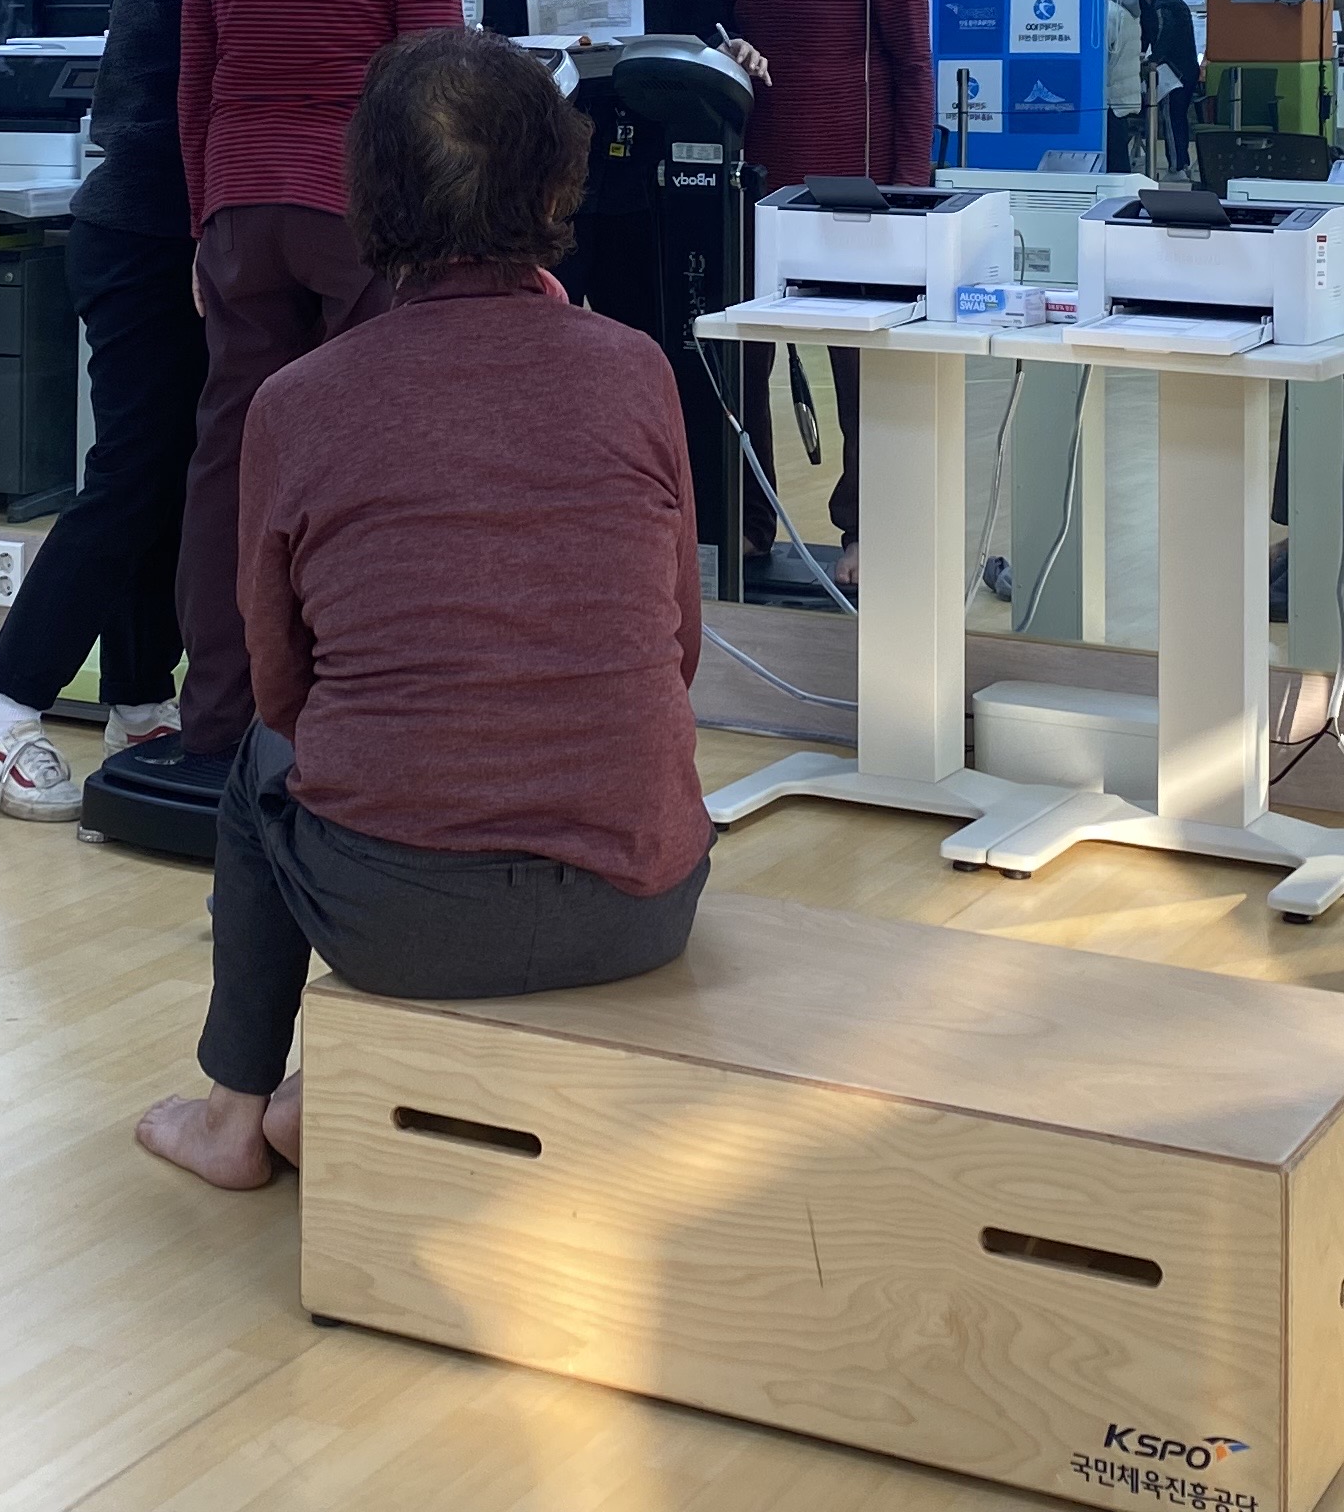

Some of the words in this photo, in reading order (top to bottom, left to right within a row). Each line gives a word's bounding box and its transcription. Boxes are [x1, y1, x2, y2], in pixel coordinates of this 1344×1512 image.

[959, 292, 999, 304] ALCOHOL
[959, 300, 987, 312] SWAB
[1103, 1423, 1212, 1470] KSPO
[1069, 1451, 1260, 1512] 국민체육진흥공단
